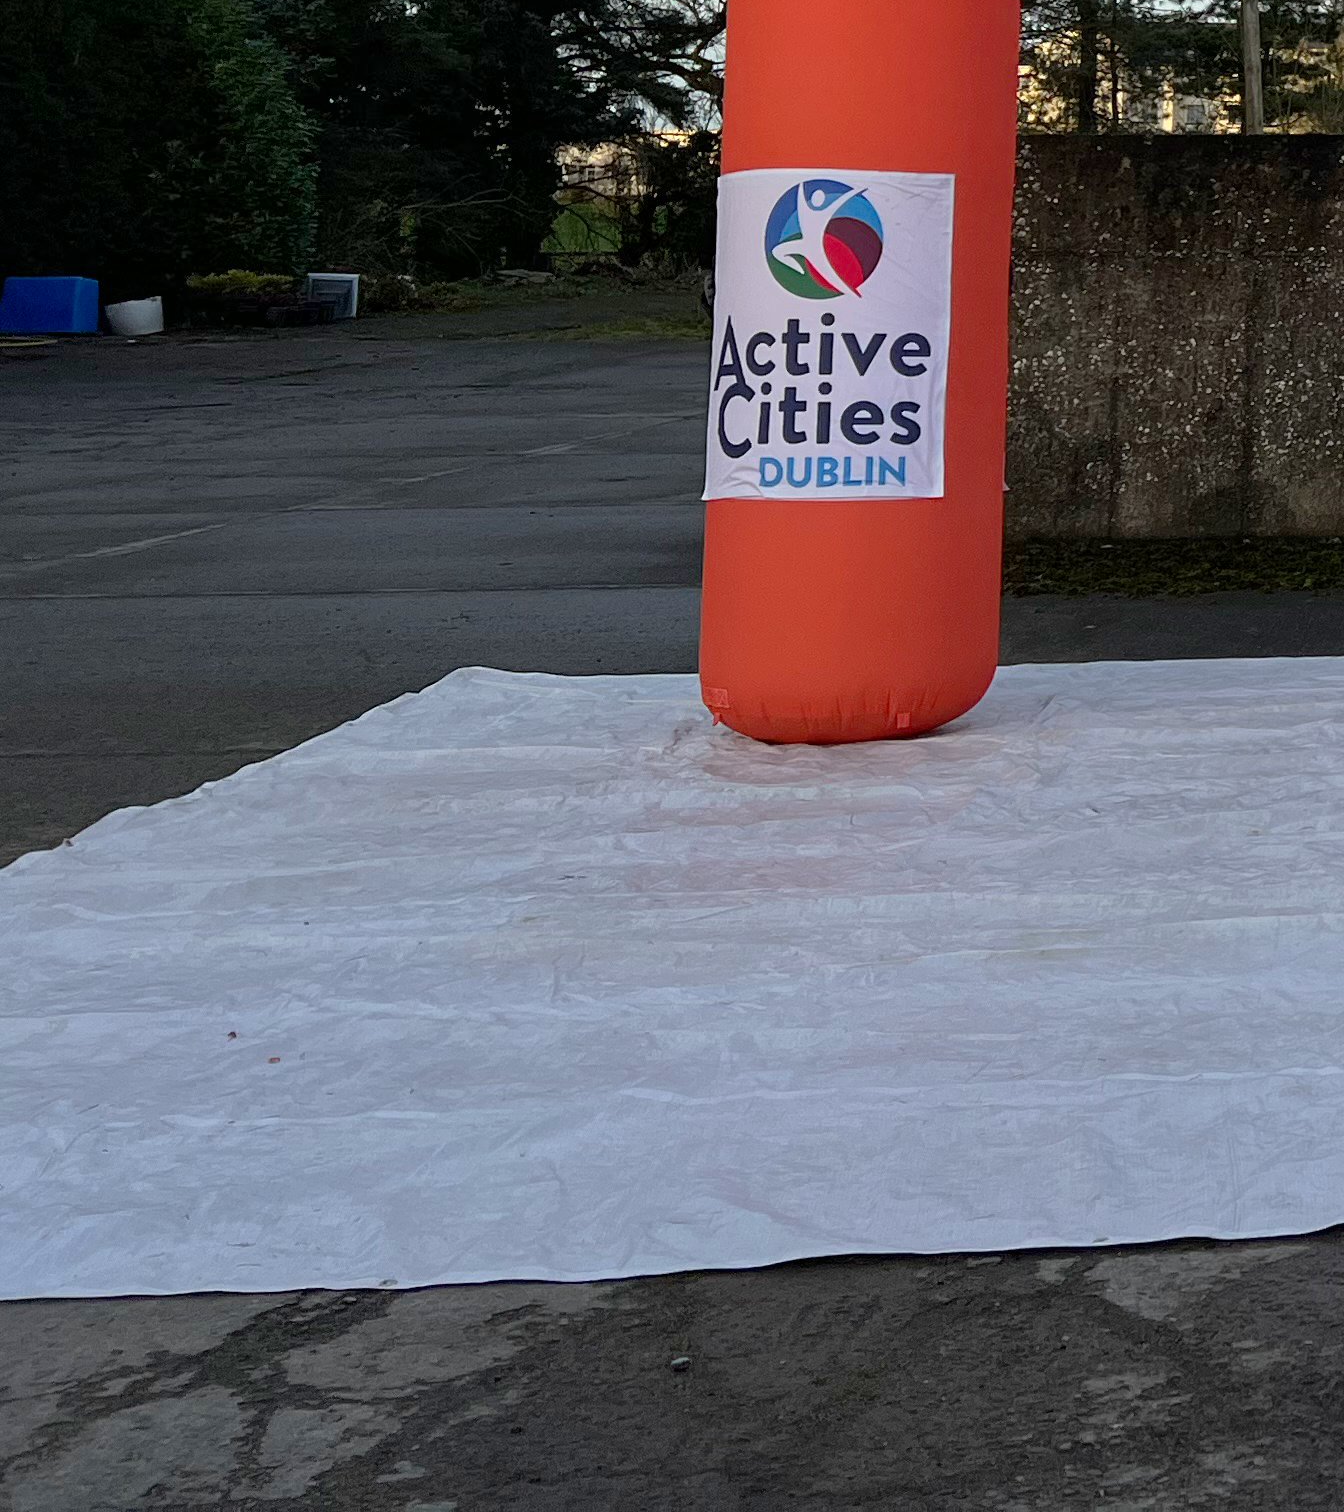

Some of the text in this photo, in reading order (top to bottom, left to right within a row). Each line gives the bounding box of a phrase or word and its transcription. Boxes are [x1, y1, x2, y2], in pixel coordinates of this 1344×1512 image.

[714, 312, 933, 392] Active
[717, 381, 922, 459] Cities
[758, 455, 907, 488] DUBLIN
